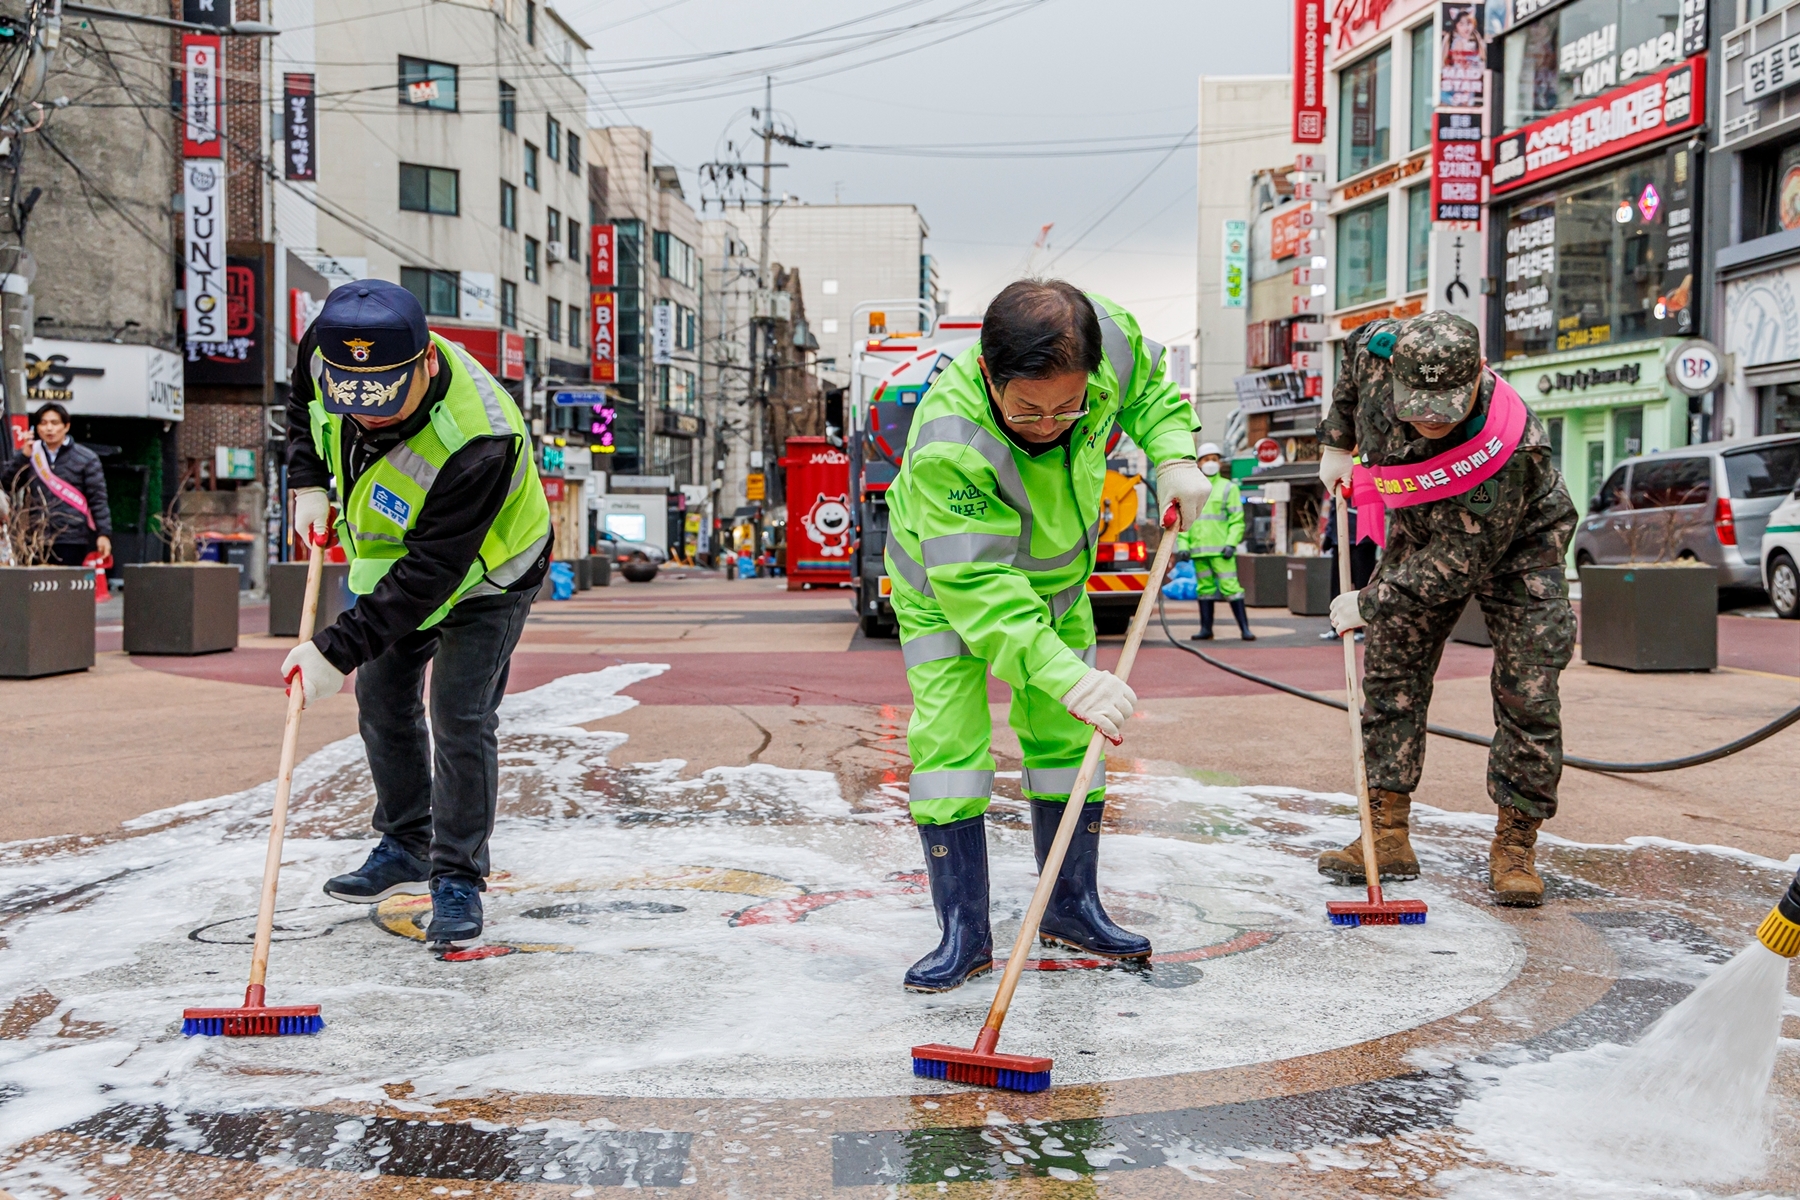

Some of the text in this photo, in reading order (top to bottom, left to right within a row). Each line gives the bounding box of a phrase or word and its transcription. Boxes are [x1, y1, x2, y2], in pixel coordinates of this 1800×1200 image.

[1442, 80, 1483, 92] STAR
[1582, 55, 1617, 95] 어서
[191, 196, 221, 336] JUNTOS
[597, 233, 609, 272] BAR
[595, 306, 613, 360] BAR
[1683, 358, 1711, 378] BR
[950, 501, 988, 517] 마포구
